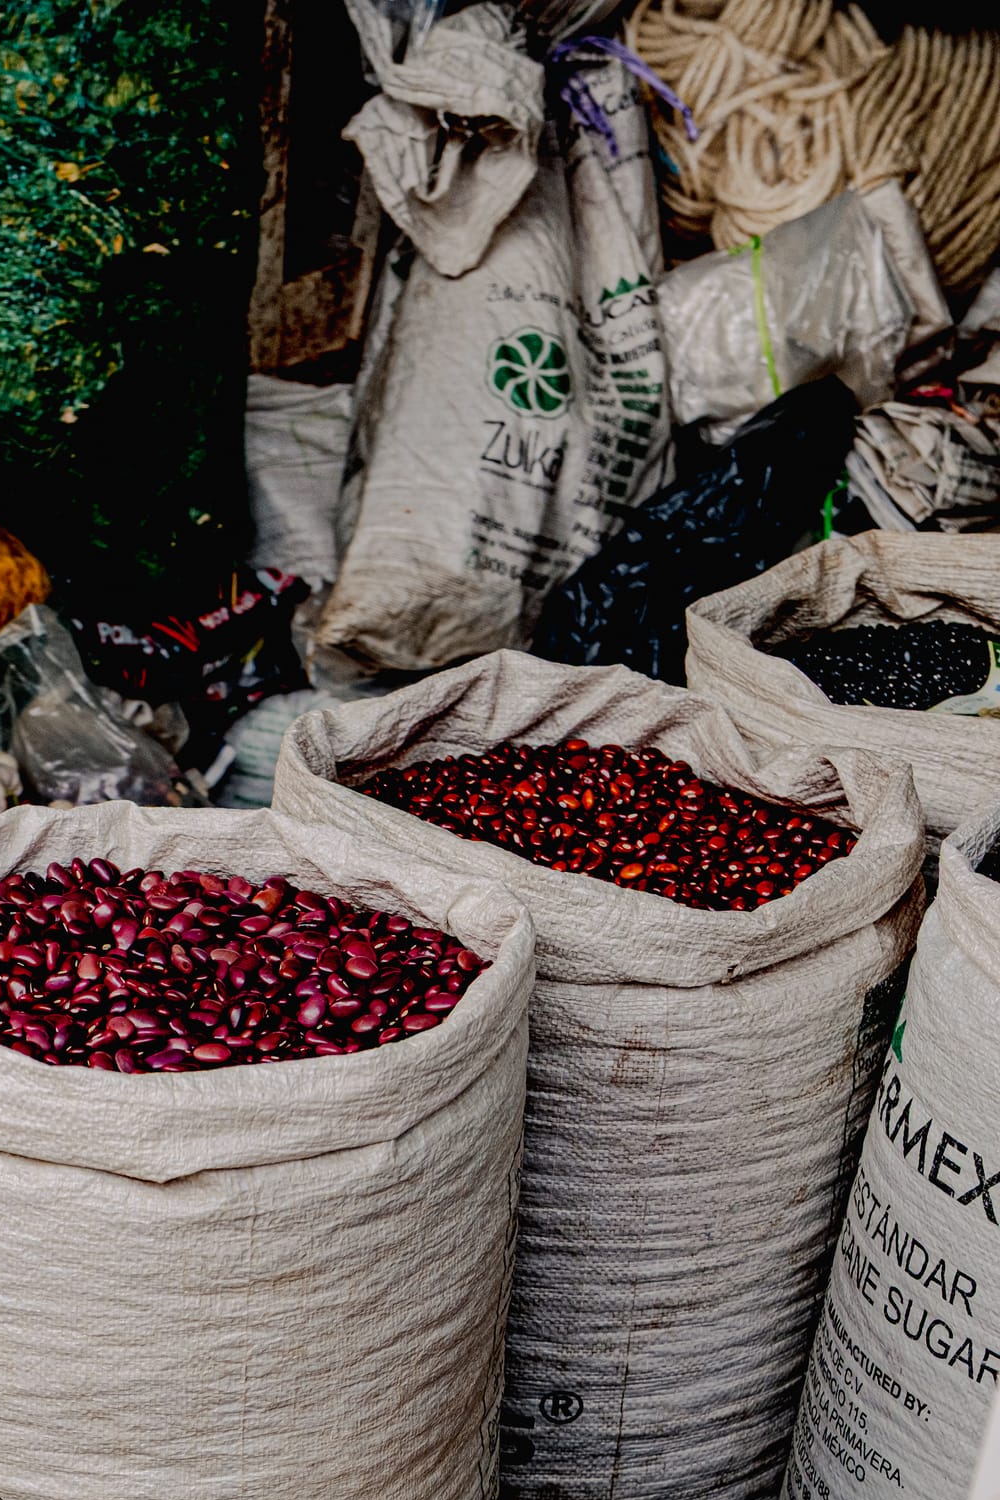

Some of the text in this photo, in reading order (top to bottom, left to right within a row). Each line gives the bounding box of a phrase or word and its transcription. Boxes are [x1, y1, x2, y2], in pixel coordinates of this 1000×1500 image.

[904, 1391, 932, 1422] BY:
[822, 1426, 866, 1482] MÉXICO
[829, 1408, 905, 1489] PRIMAVERA.
